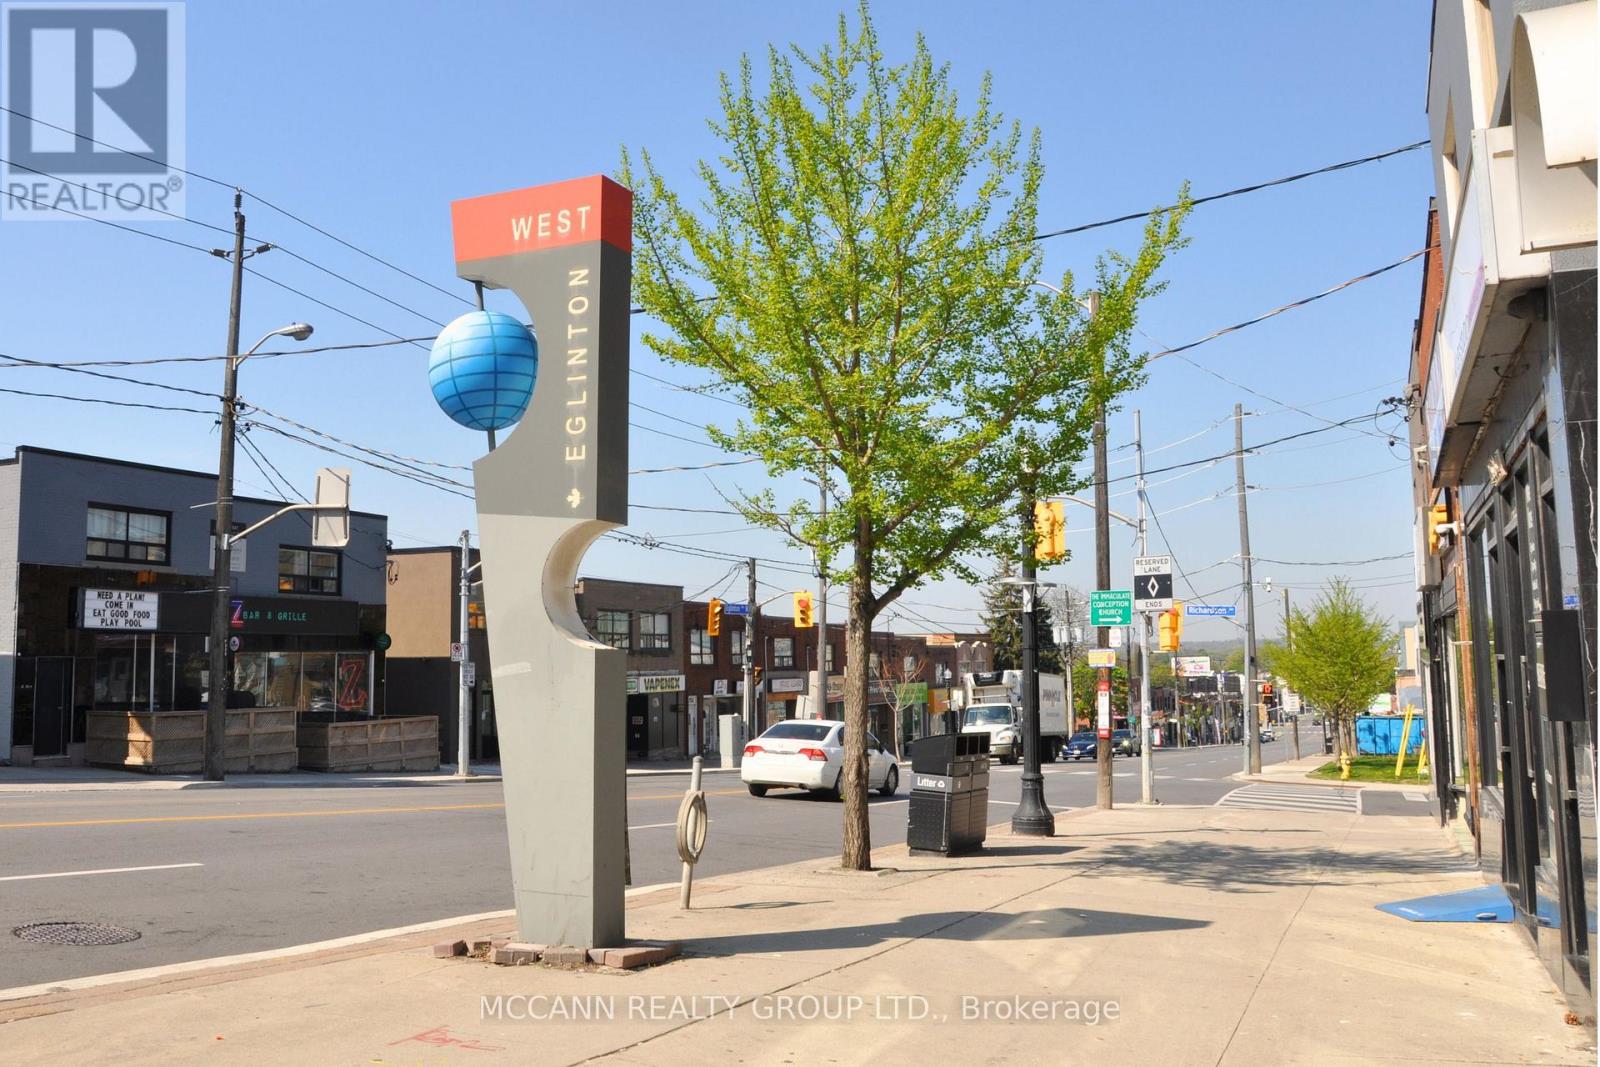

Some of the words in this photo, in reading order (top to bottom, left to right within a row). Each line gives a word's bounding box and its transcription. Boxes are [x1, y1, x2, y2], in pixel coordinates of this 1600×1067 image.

[511, 205, 592, 241] WEST
[565, 268, 589, 463] EGLINTON
[1135, 558, 1169, 566] RESERVED
[97, 591, 113, 600] NEED
[117, 592, 122, 601] A
[105, 601, 123, 609] COME
[126, 601, 134, 610] IN
[1093, 600, 1129, 608] CONCEPTION
[93, 609, 106, 617] EAT
[110, 609, 129, 618] GOOD
[133, 611, 151, 619] FOOD
[242, 610, 260, 620] BAR
[277, 611, 307, 622] GRILLE
[100, 618, 119, 627] PLAY
[125, 619, 142, 628] POOL
[917, 776, 937, 788] Litter
